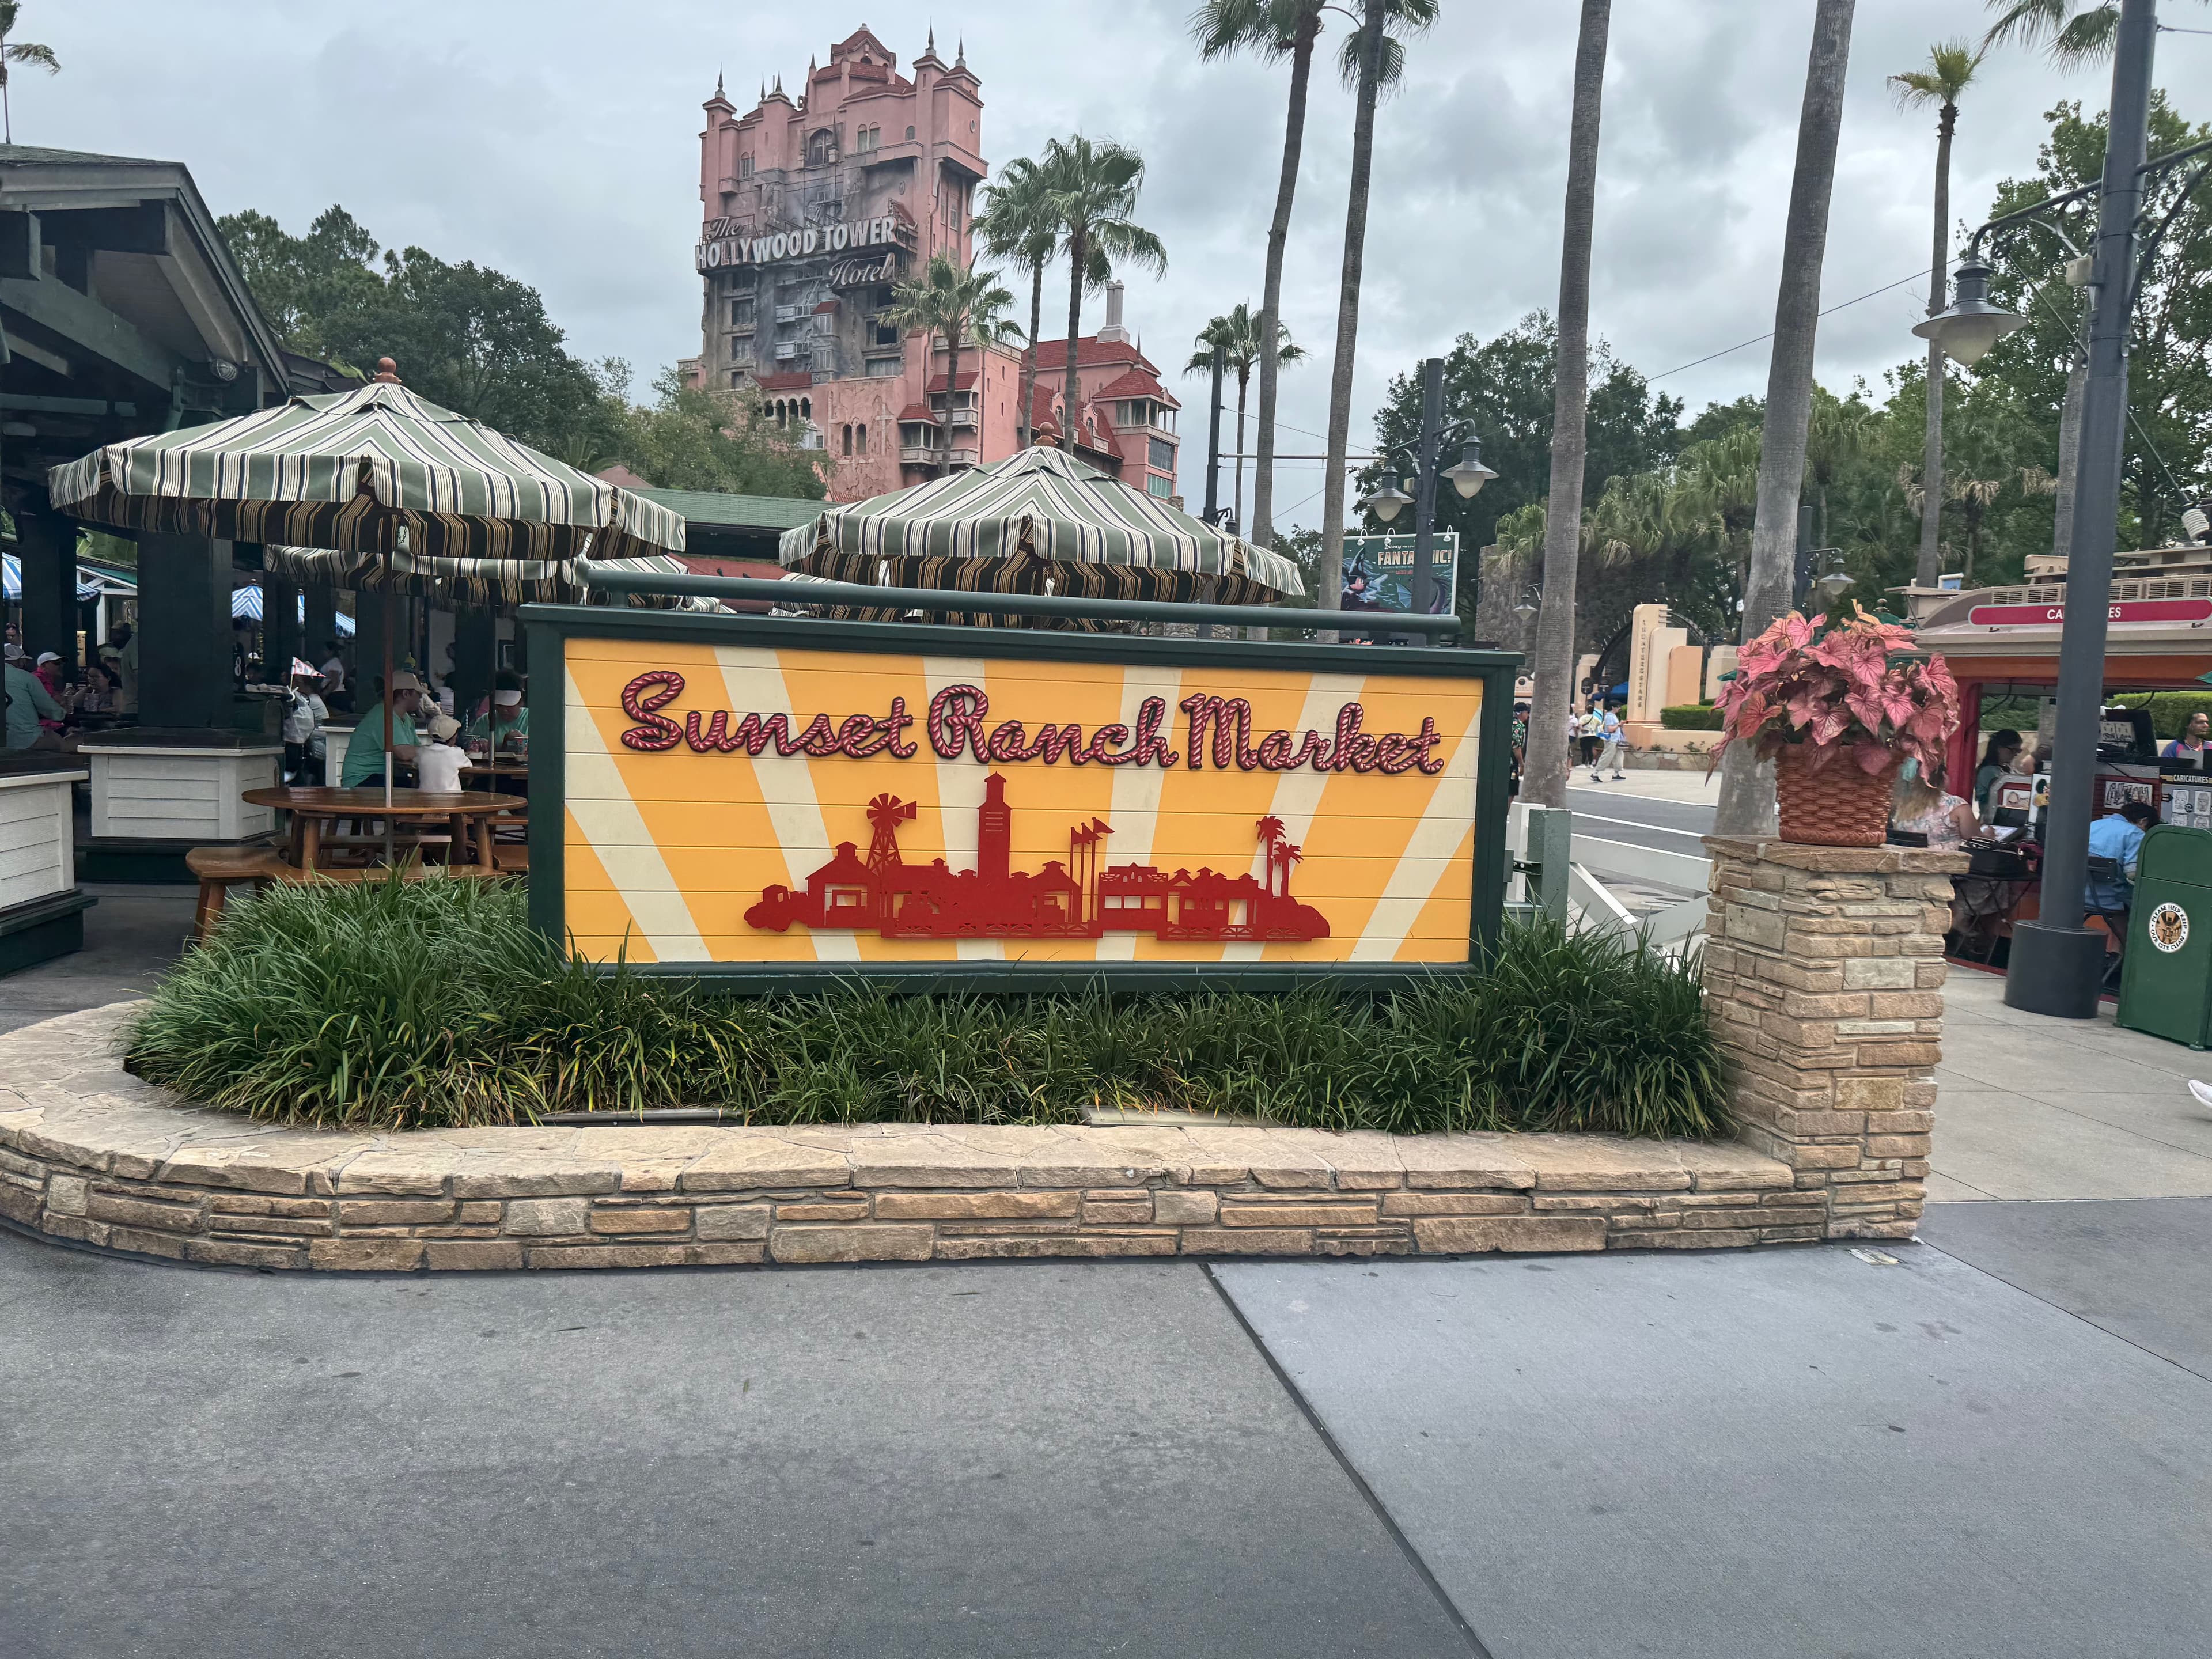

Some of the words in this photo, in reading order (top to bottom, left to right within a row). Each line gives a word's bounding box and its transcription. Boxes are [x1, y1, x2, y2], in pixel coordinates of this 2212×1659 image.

[706, 216, 741, 240] The
[695, 228, 818, 270] HOLLYWOOD
[822, 216, 897, 251] TOWER
[826, 252, 895, 288] Hotel
[1378, 549, 1452, 565] FANTAIC!
[621, 671, 918, 757] Sunset
[927, 684, 1179, 766] Ranch
[1179, 692, 1444, 775] Market
[2173, 775, 2209, 783] CARICATURES
[2152, 905, 2166, 922] PLEASE
[2150, 929, 2158, 942] OUR
[2171, 936, 2185, 950] CLEAN
